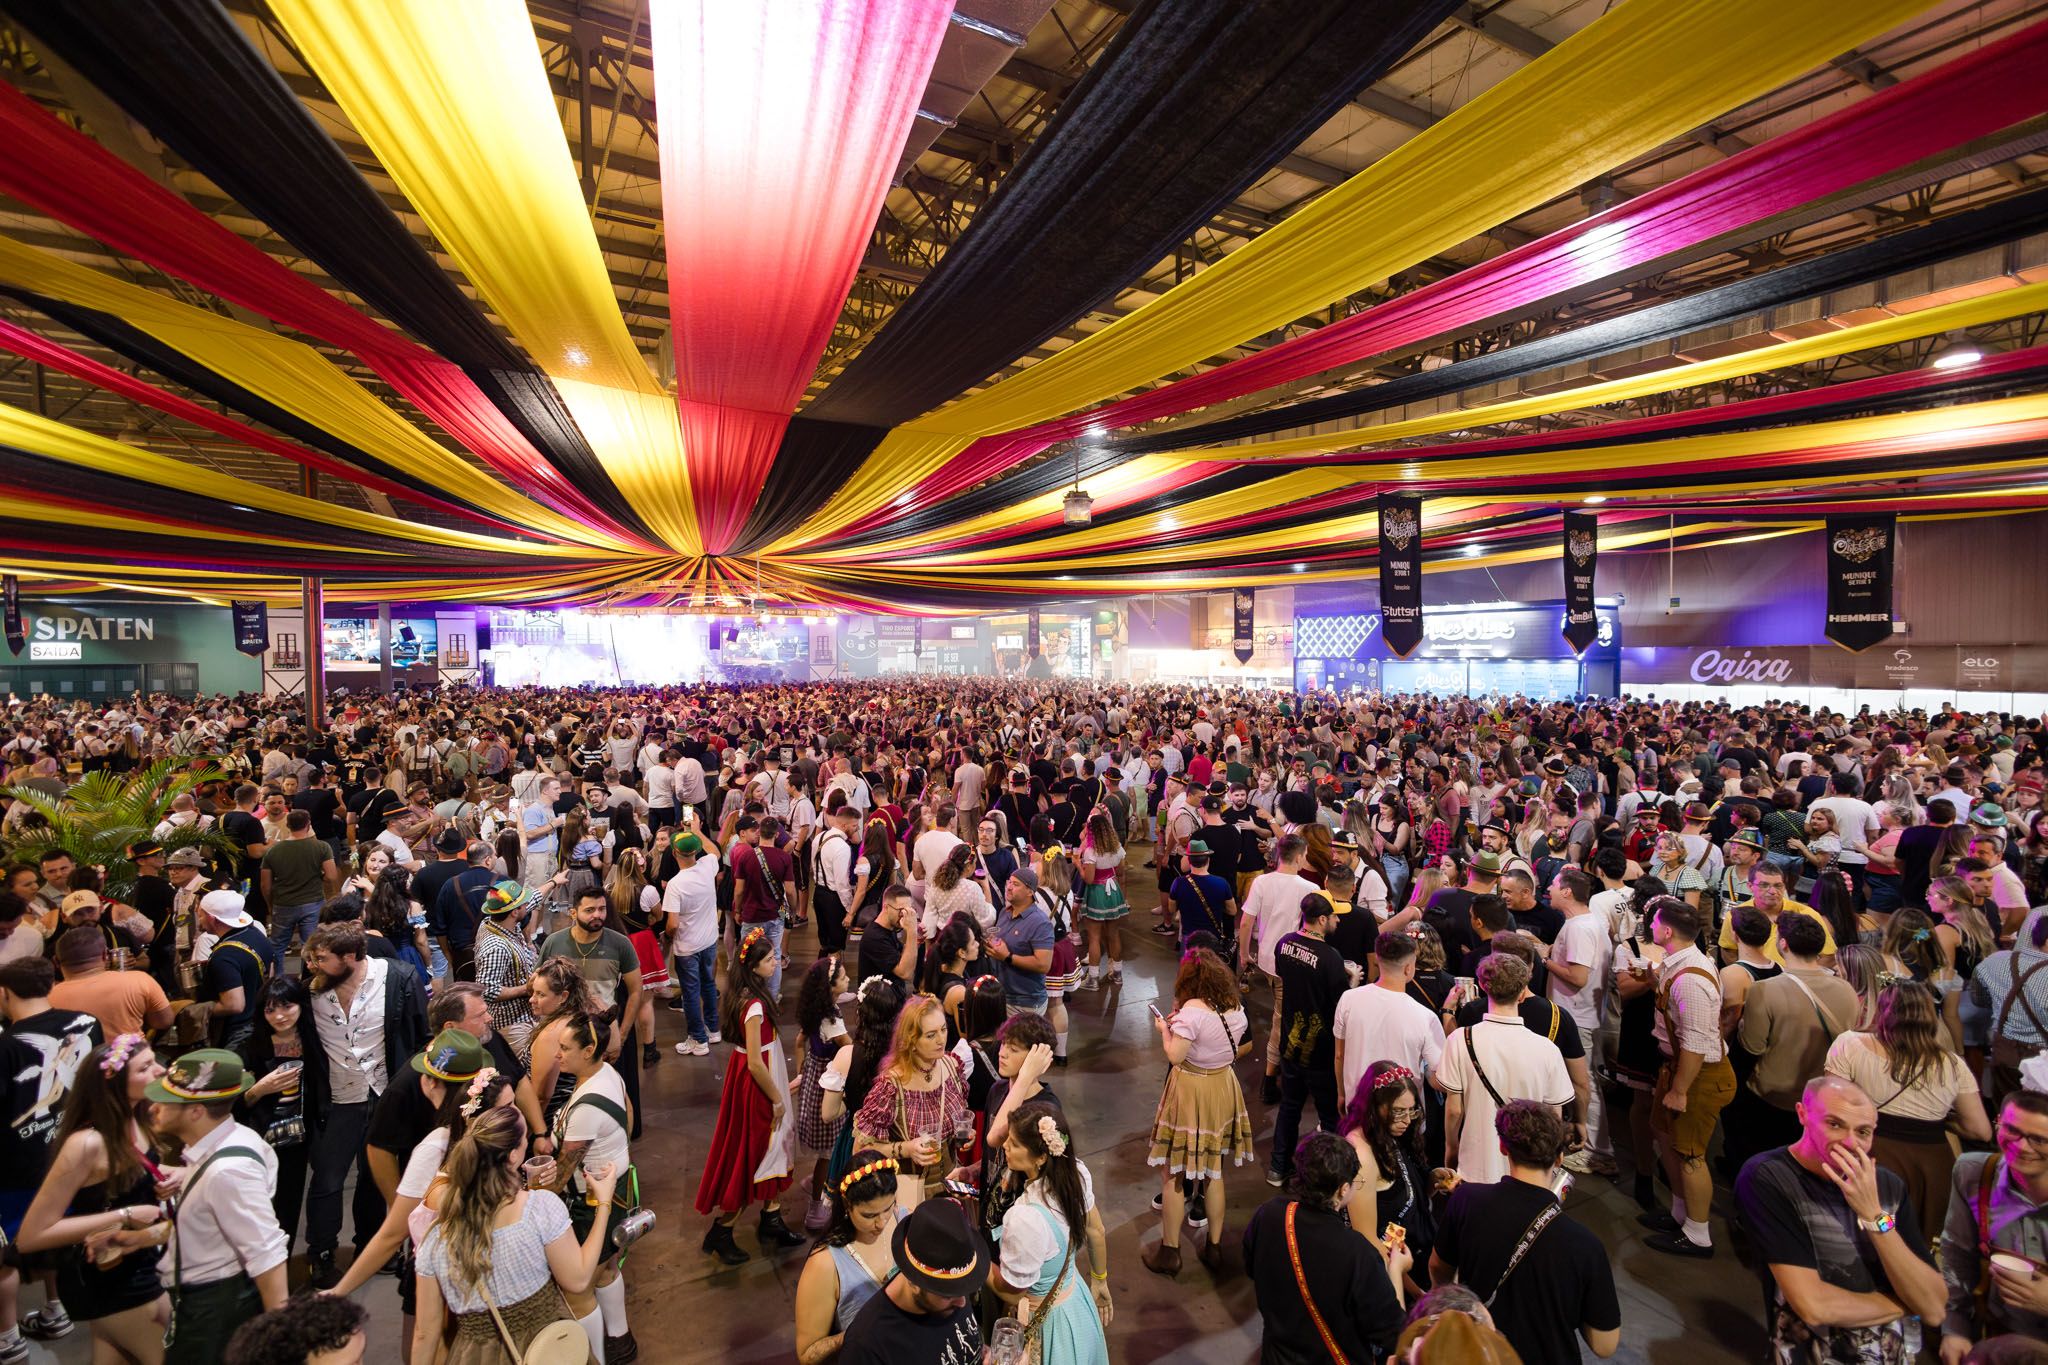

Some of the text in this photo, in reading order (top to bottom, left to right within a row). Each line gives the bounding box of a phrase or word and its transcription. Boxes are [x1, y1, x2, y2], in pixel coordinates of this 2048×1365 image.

[1842, 572, 1877, 581] MUNIQUE
[1828, 613, 1889, 623] HEMMER
[34, 617, 154, 640] SPATEN
[1690, 650, 1793, 682] Caixa
